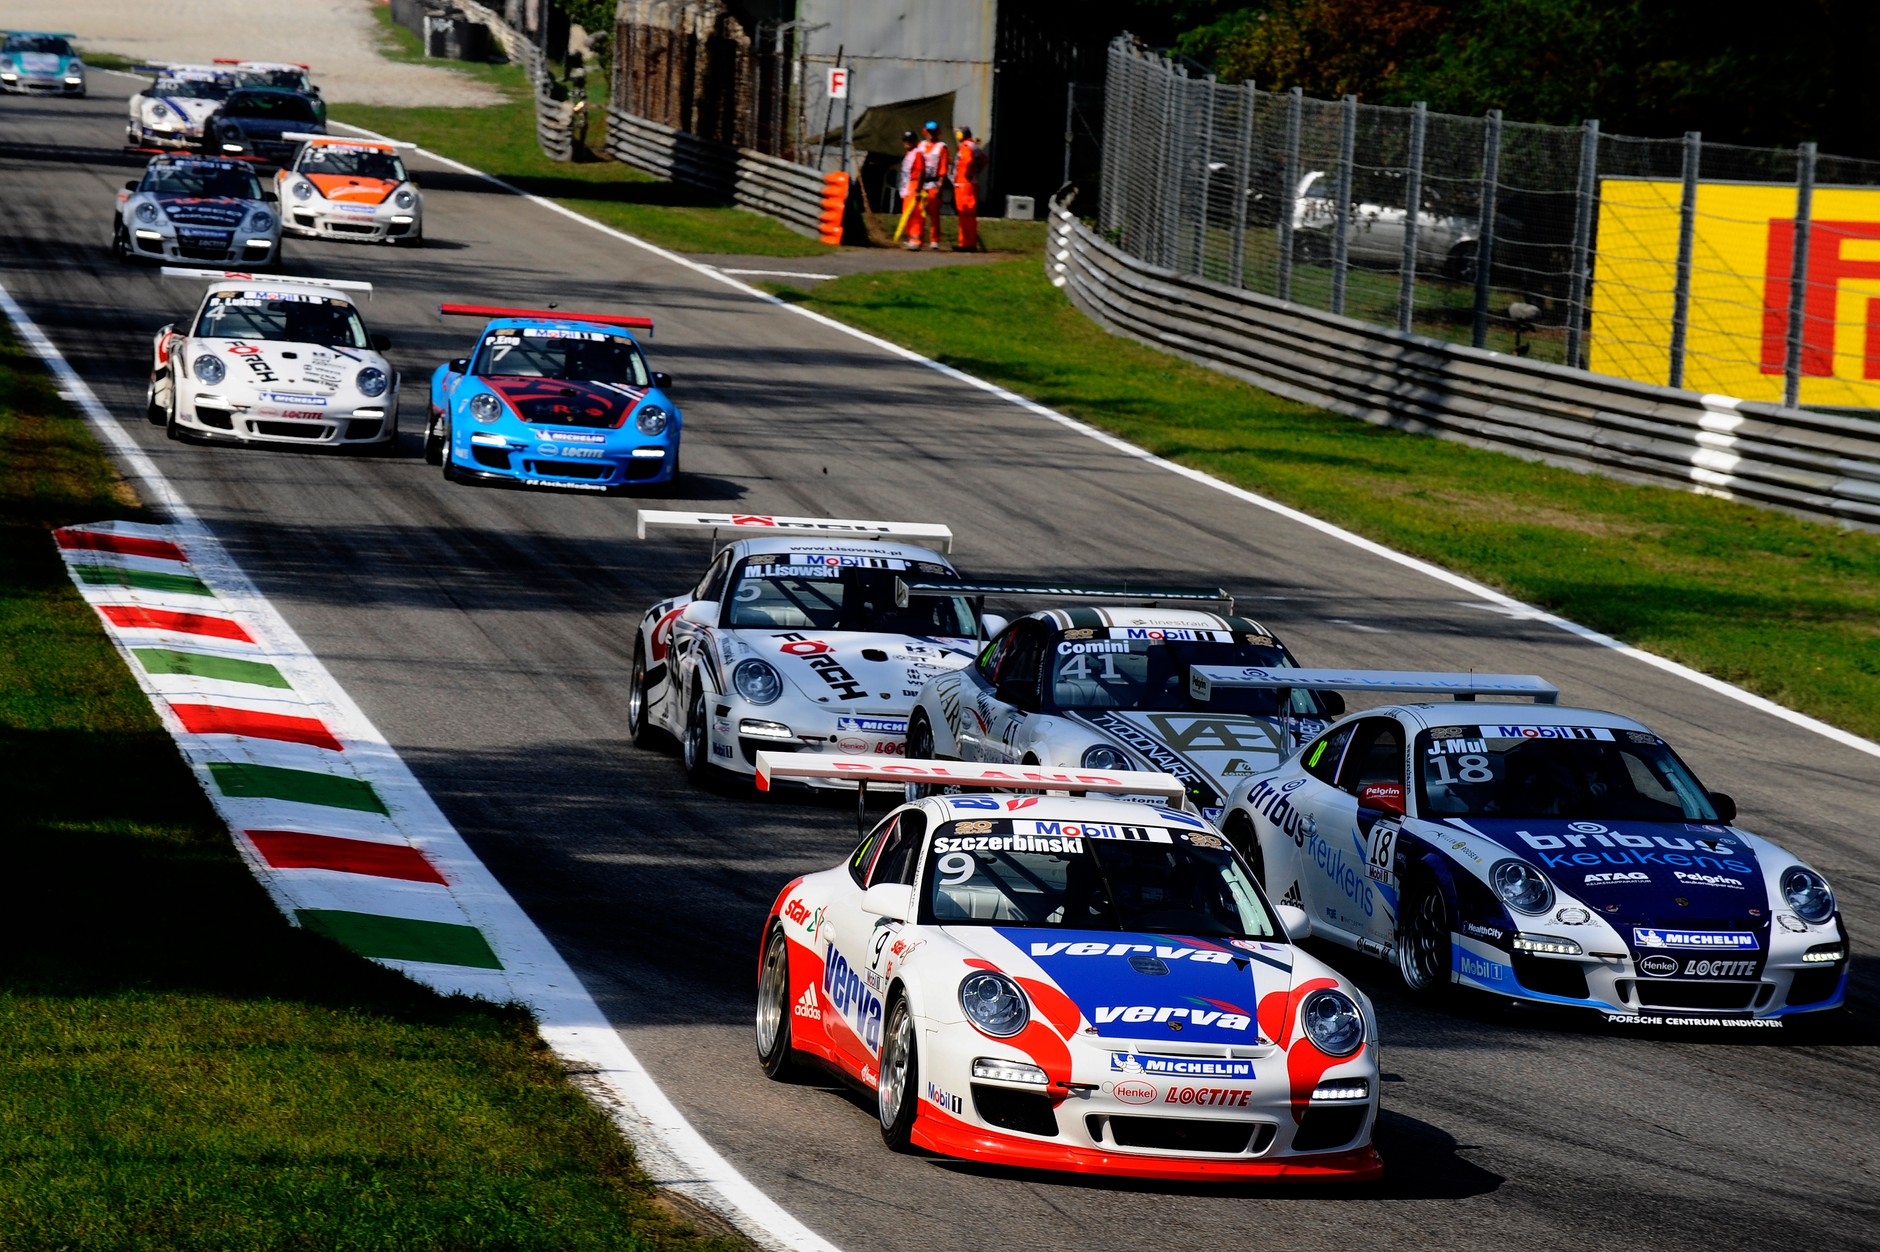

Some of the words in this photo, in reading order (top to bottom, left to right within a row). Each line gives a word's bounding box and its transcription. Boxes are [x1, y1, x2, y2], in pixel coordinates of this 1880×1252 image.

[831, 72, 845, 93] F
[206, 305, 226, 320] 4
[485, 335, 520, 346] P.Eng
[492, 346, 513, 361] 7
[282, 410, 323, 419] LOCTITE
[552, 434, 605, 443] MICHELIN
[561, 447, 605, 458] LOCTITE
[807, 555, 865, 567] Mobil
[744, 564, 840, 578] M.Lisowski
[734, 579, 761, 601] 5
[1128, 629, 1191, 641] Mobil
[1057, 640, 1130, 655] Comini
[1058, 654, 1122, 679] 41
[1498, 726, 1570, 739] Mobil
[1309, 740, 1327, 767] 18
[1427, 739, 1489, 755] J.Mul
[832, 762, 1123, 786] POLAND
[1429, 754, 1494, 785] 18
[1366, 787, 1400, 796] Pelgrim
[1246, 777, 1305, 848] bribus
[1036, 821, 1117, 838] Mobil
[933, 834, 1084, 854] Szczerbinski
[1370, 828, 1393, 868] 18
[1515, 829, 1734, 855] bribus
[937, 852, 976, 885] 9
[1538, 849, 1753, 874] keukens
[1308, 832, 1374, 918] keukens
[1584, 872, 1649, 883] ATAG
[1673, 871, 1743, 886] Pelgrim
[785, 898, 811, 926] star
[1468, 923, 1503, 939] HealthCity
[1666, 932, 1752, 946] MICHELIN
[871, 930, 890, 970] 9
[1030, 941, 1235, 965] verva
[1461, 957, 1490, 979] Mobil
[1643, 960, 1677, 971] Henkel
[1684, 960, 1757, 976] LOCTITE
[822, 943, 882, 1054] verva
[794, 1004, 822, 1020] adidas
[1095, 1005, 1251, 1031] verva
[1608, 1014, 1663, 1025] PORSCHE
[1665, 1017, 1721, 1027] CENTRUM
[1722, 1018, 1784, 1029] EINDHOVEN
[1145, 1060, 1250, 1076] MICHELIN
[928, 1081, 951, 1111] Mobil
[1116, 1086, 1155, 1100] Henkel
[1165, 1086, 1253, 1107] LOCTITE
